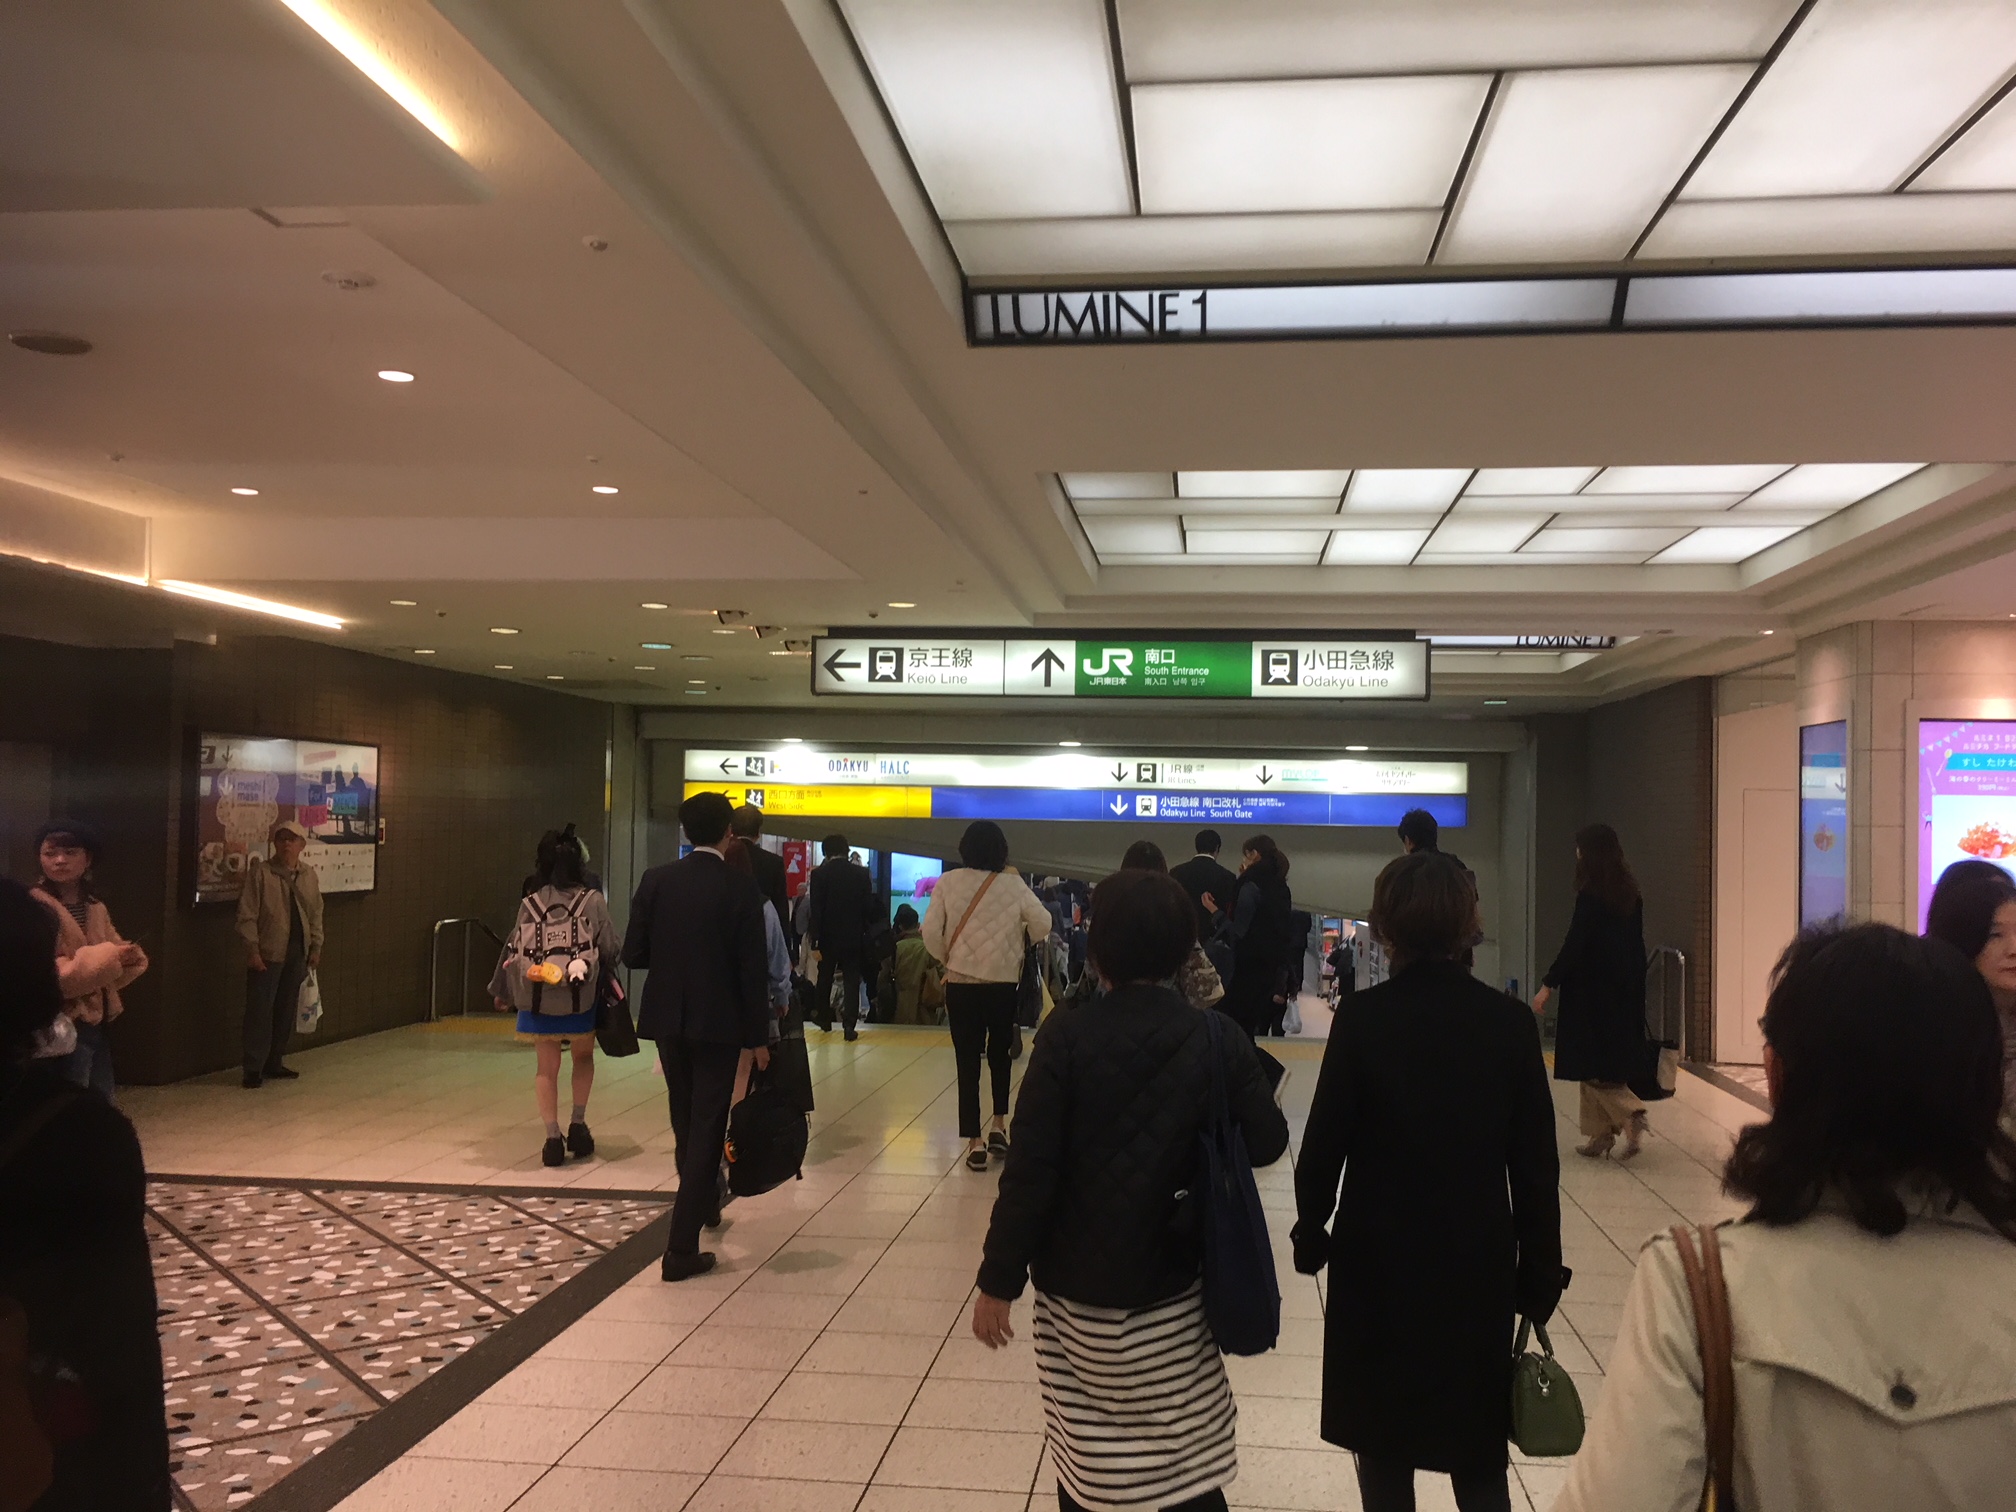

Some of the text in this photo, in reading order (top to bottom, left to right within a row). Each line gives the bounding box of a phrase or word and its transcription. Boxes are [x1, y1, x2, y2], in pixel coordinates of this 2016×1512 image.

[990, 290, 1208, 339] LUMINE 1
[908, 647, 973, 669] 京王線
[1082, 647, 1134, 676] JR
[1144, 648, 1175, 664] 南口
[1303, 649, 1395, 671] 小田急線
[1144, 666, 1210, 676] South Entrance
[941, 673, 968, 684] Line
[1089, 677, 1127, 686] JR東日本
[1360, 674, 1389, 687] Line
[828, 758, 869, 772] ODAKYU
[880, 760, 910, 775] HALC
[1962, 757, 1981, 768] すし
[1160, 796, 1199, 808] 小田急線
[1202, 797, 1242, 809] 南口改札
[1160, 808, 1253, 818] Odakyu Line South Gate
